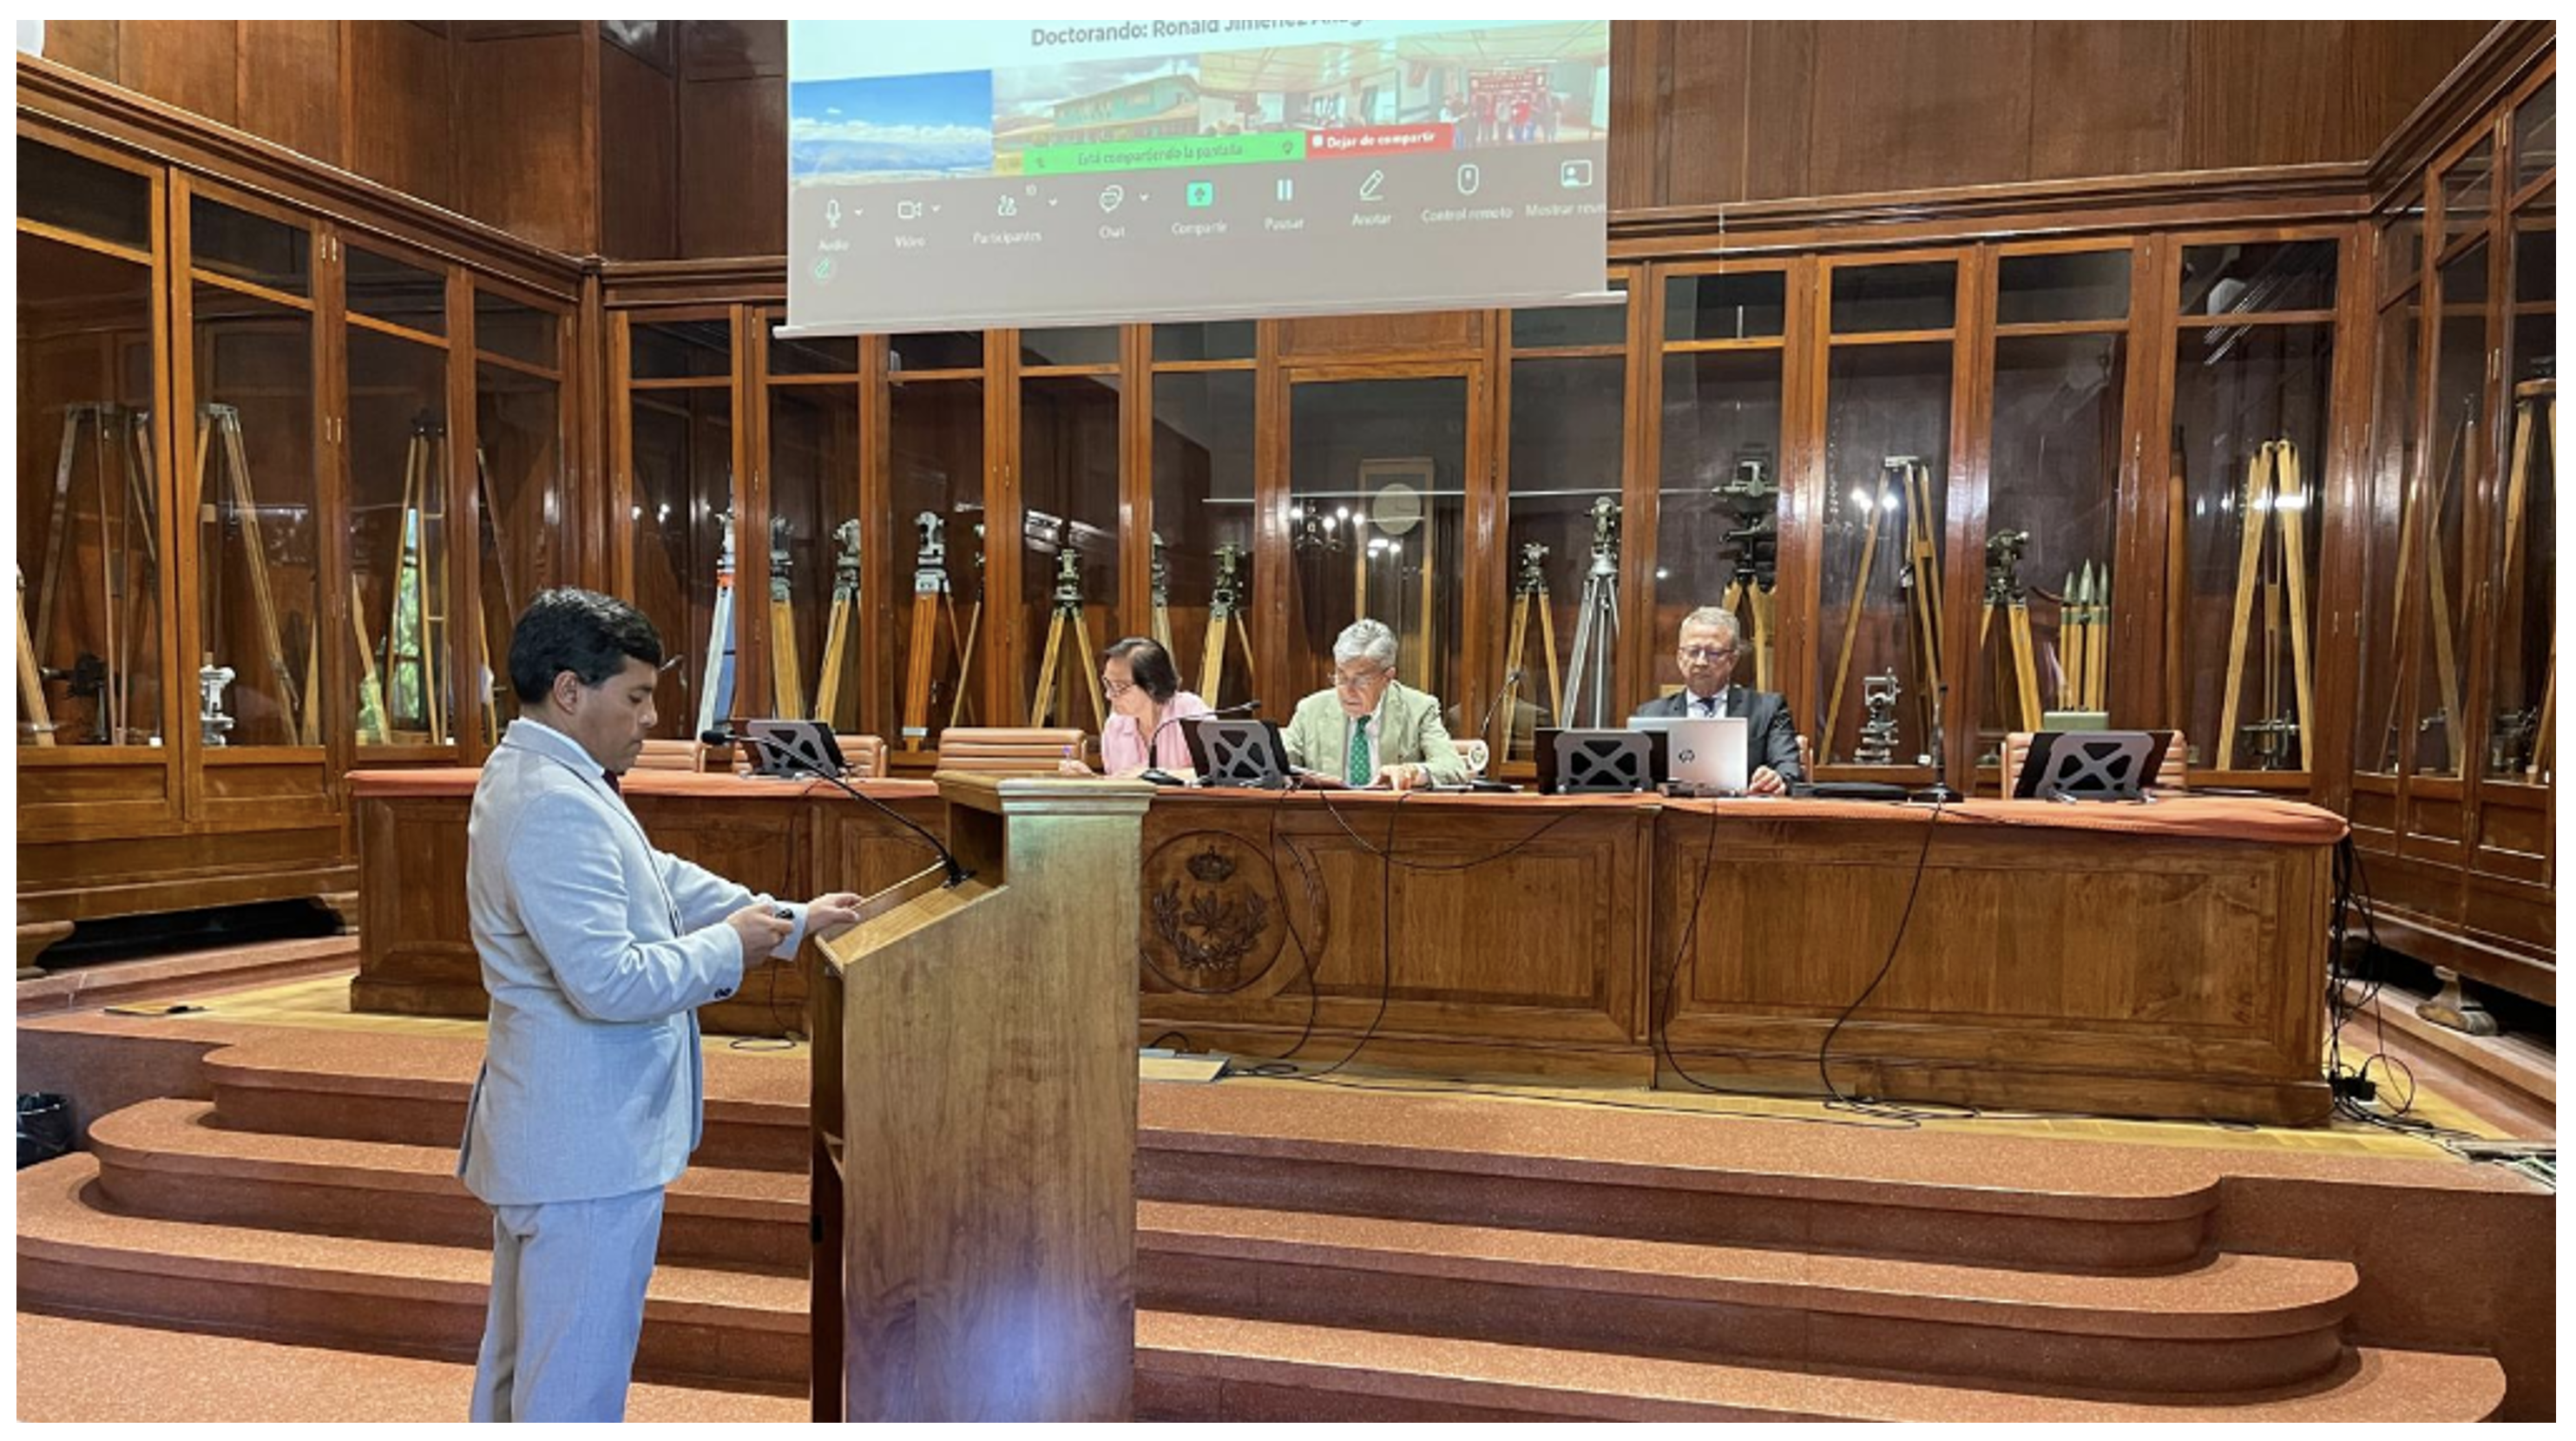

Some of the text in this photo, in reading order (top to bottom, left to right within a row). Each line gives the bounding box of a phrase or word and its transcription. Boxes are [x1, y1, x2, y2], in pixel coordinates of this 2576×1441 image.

[1031, 21, 1147, 46] Doctorando:
[1153, 19, 1219, 38] Ronald
[1327, 130, 1436, 149] Dejar de compartir
[1196, 143, 1243, 160] pantalla
[1421, 207, 1514, 223] Control remoto
[1526, 203, 1574, 217] Mostrar
[1172, 220, 1228, 236] Compartir
[1264, 216, 1304, 231] Pausar
[1351, 213, 1391, 227] Anotar
[973, 230, 1042, 246] Participantes
[1099, 225, 1125, 239] Chat
[818, 238, 850, 252] Audio
